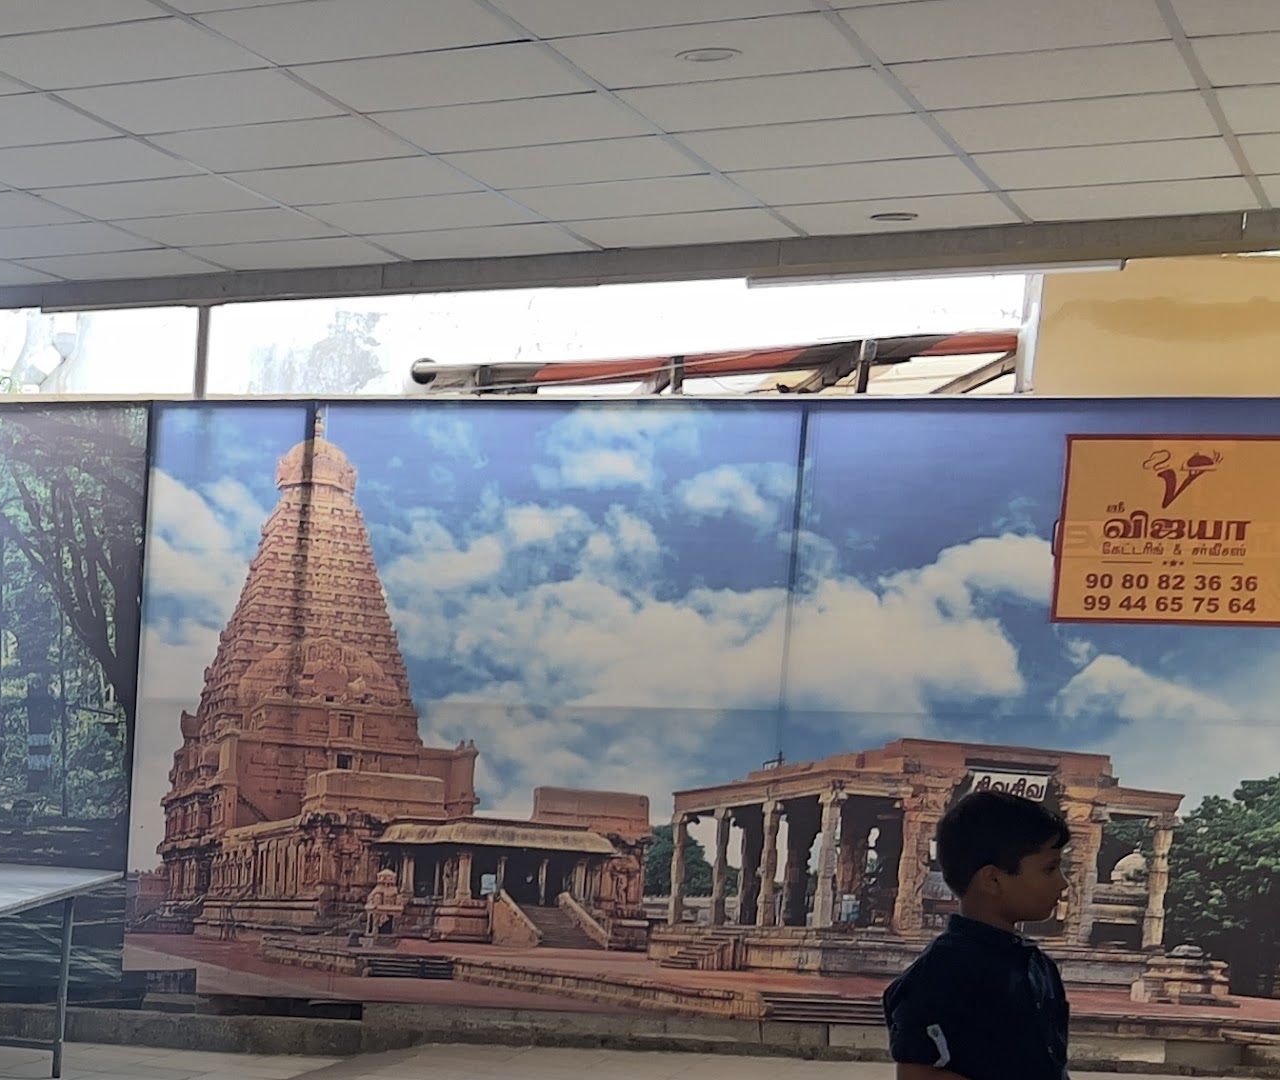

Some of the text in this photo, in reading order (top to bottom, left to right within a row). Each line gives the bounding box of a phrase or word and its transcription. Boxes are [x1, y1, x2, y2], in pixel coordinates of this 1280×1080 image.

[1103, 510, 1252, 541] விஜயா
[1102, 541, 1164, 555] கேட்டரிங்
[1173, 543, 1182, 556] &
[1085, 573, 1258, 592] 90 80 82 36 36
[1083, 595, 1257, 614] 99 44 65 75 64
